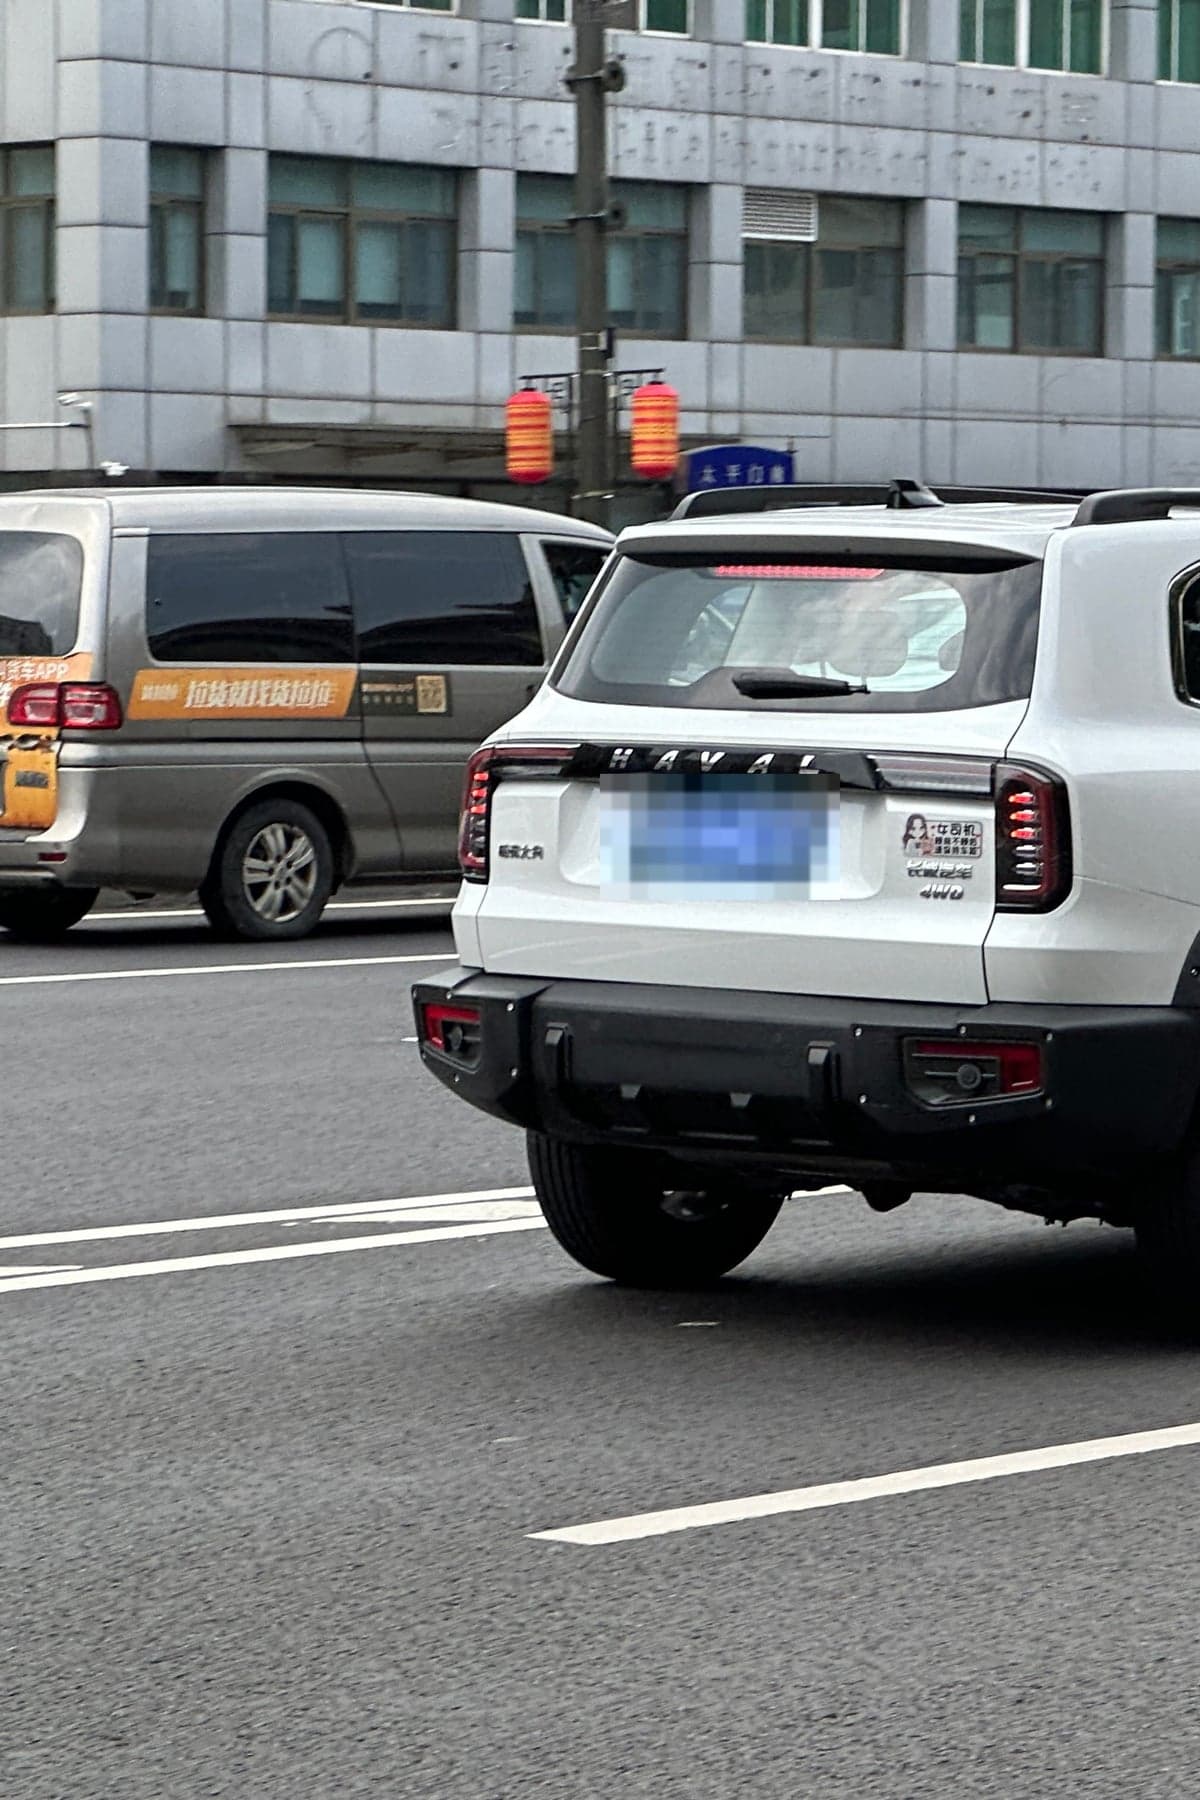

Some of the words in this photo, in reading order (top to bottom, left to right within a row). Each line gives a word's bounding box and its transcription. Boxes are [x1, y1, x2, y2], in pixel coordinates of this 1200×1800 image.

[608, 748, 819, 774] HAVAL
[937, 823, 976, 836] 女司机
[907, 860, 973, 879] 长城汽车
[920, 884, 964, 900] 4WD
